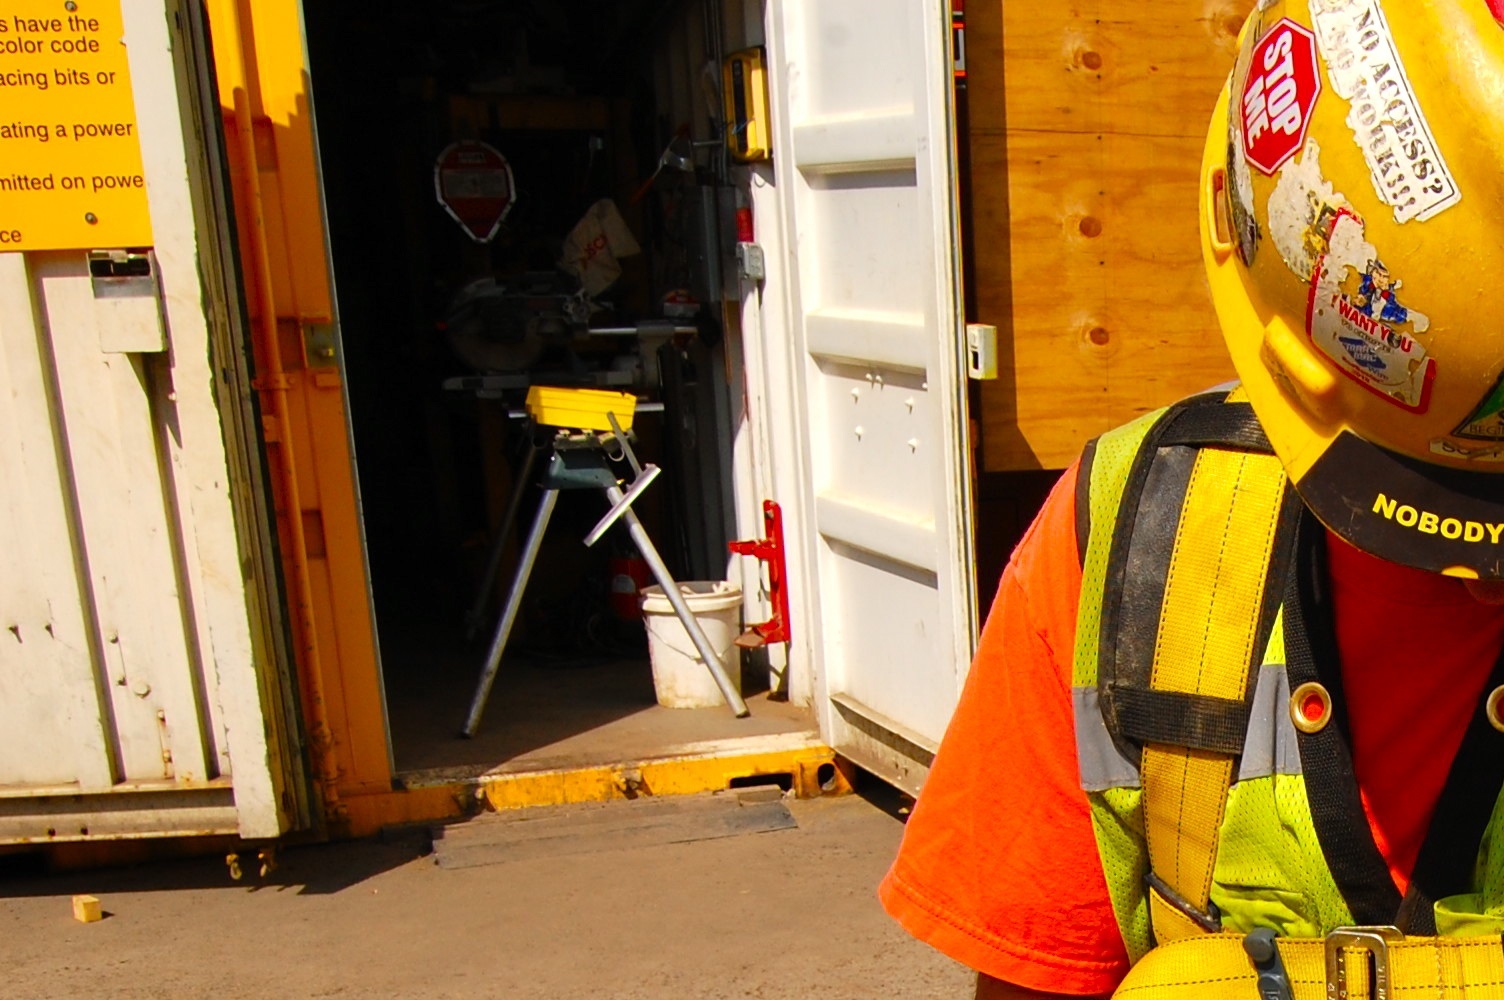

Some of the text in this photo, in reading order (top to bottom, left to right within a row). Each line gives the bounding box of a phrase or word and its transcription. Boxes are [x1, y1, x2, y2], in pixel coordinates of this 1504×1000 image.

[14, 15, 62, 32] have
[68, 15, 99, 32] the
[0, 36, 99, 54] color code
[54, 68, 90, 85] bits
[96, 71, 116, 84] or
[1264, 31, 1302, 136] STOP
[1245, 75, 1270, 149] ME
[55, 124, 67, 137] a
[73, 123, 132, 141] power
[1370, 63, 1443, 194] ACCESS?
[61, 176, 85, 190] on
[1339, 299, 1379, 335] WANT
[1373, 493, 1504, 544] NOBODY
